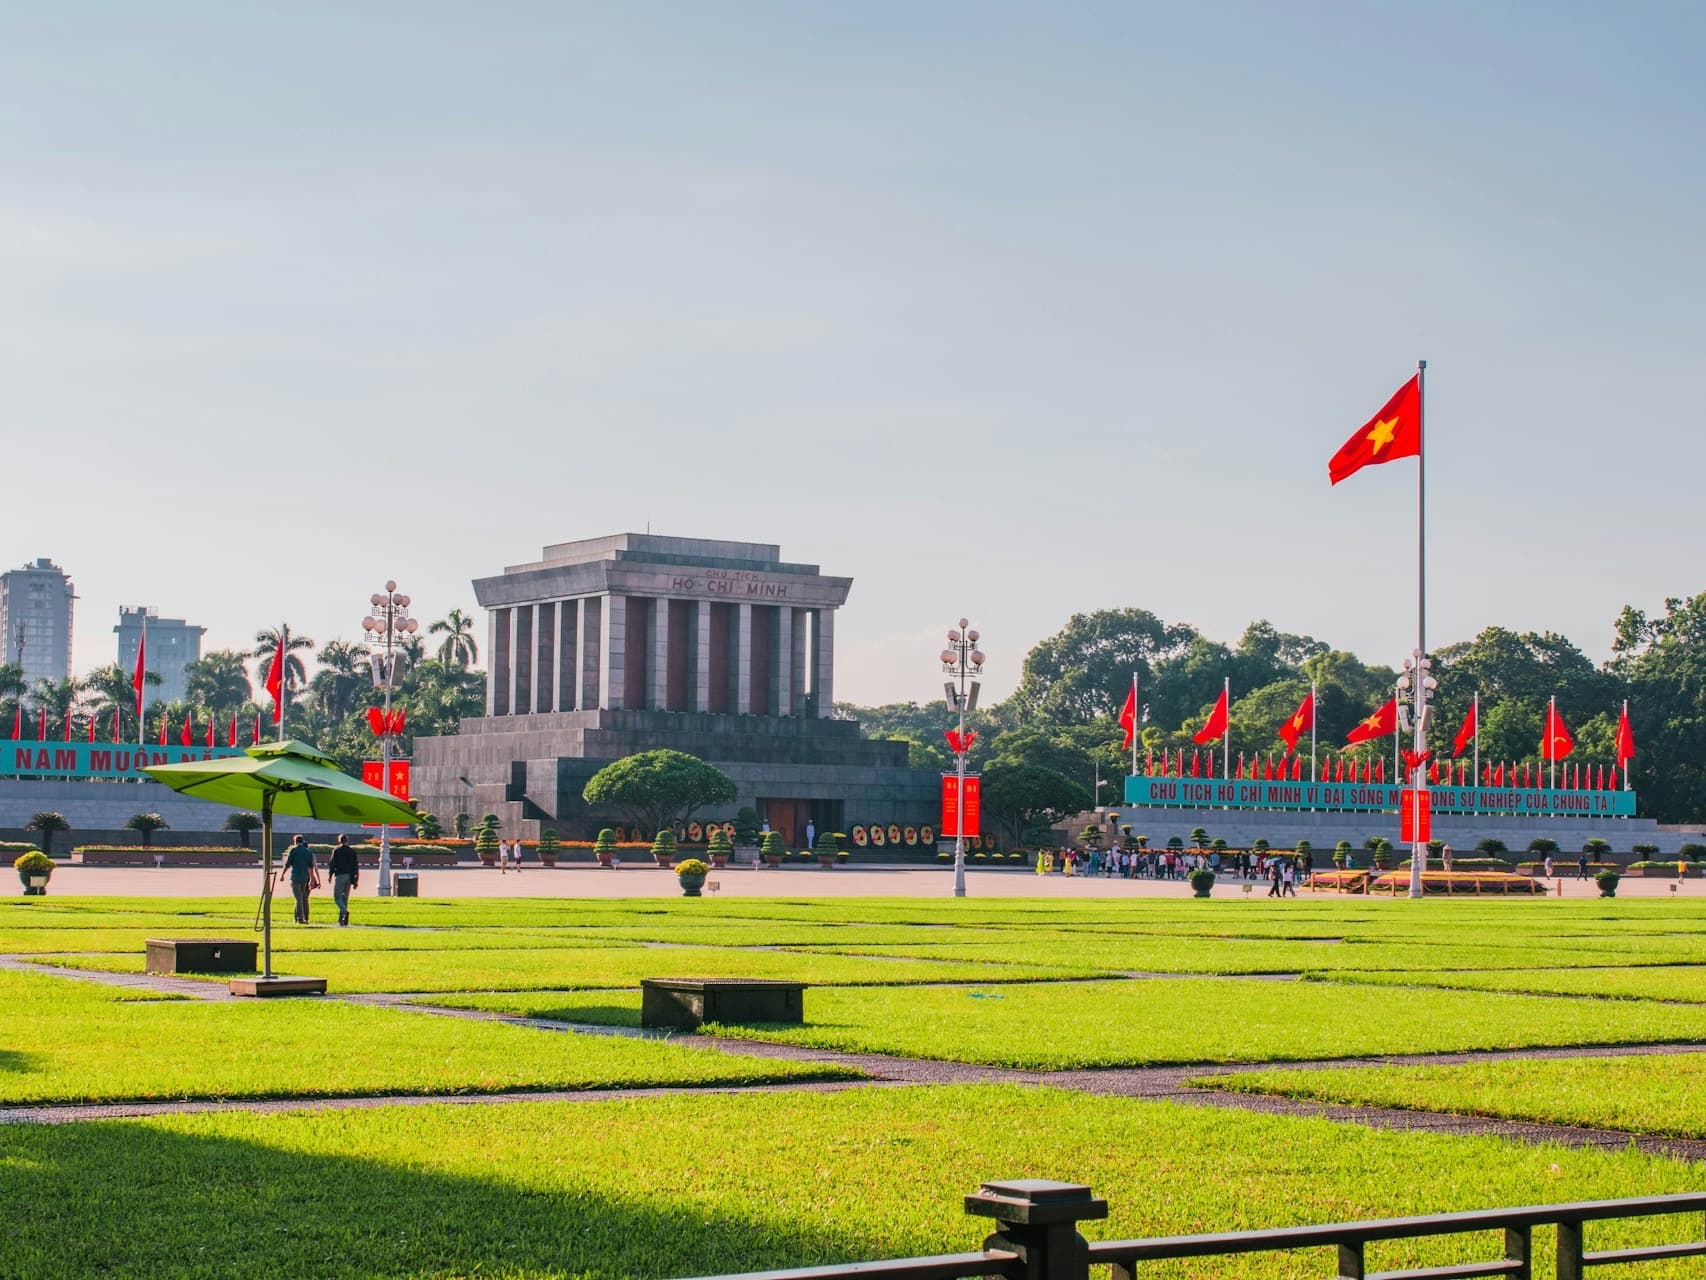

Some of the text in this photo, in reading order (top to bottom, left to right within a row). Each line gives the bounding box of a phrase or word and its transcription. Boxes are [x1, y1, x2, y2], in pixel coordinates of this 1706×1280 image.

[747, 583, 787, 598] MINH
[15, 747, 77, 771] NAM
[1182, 783, 1212, 804] TỊCH
[1240, 782, 1262, 803] CHÍ
[1268, 786, 1301, 804] MINH
[1350, 784, 1384, 806] SỐNG
[1480, 789, 1522, 812] NGHIỆP
[1553, 791, 1590, 810] CHÚNG
[1594, 795, 1608, 811] TA
